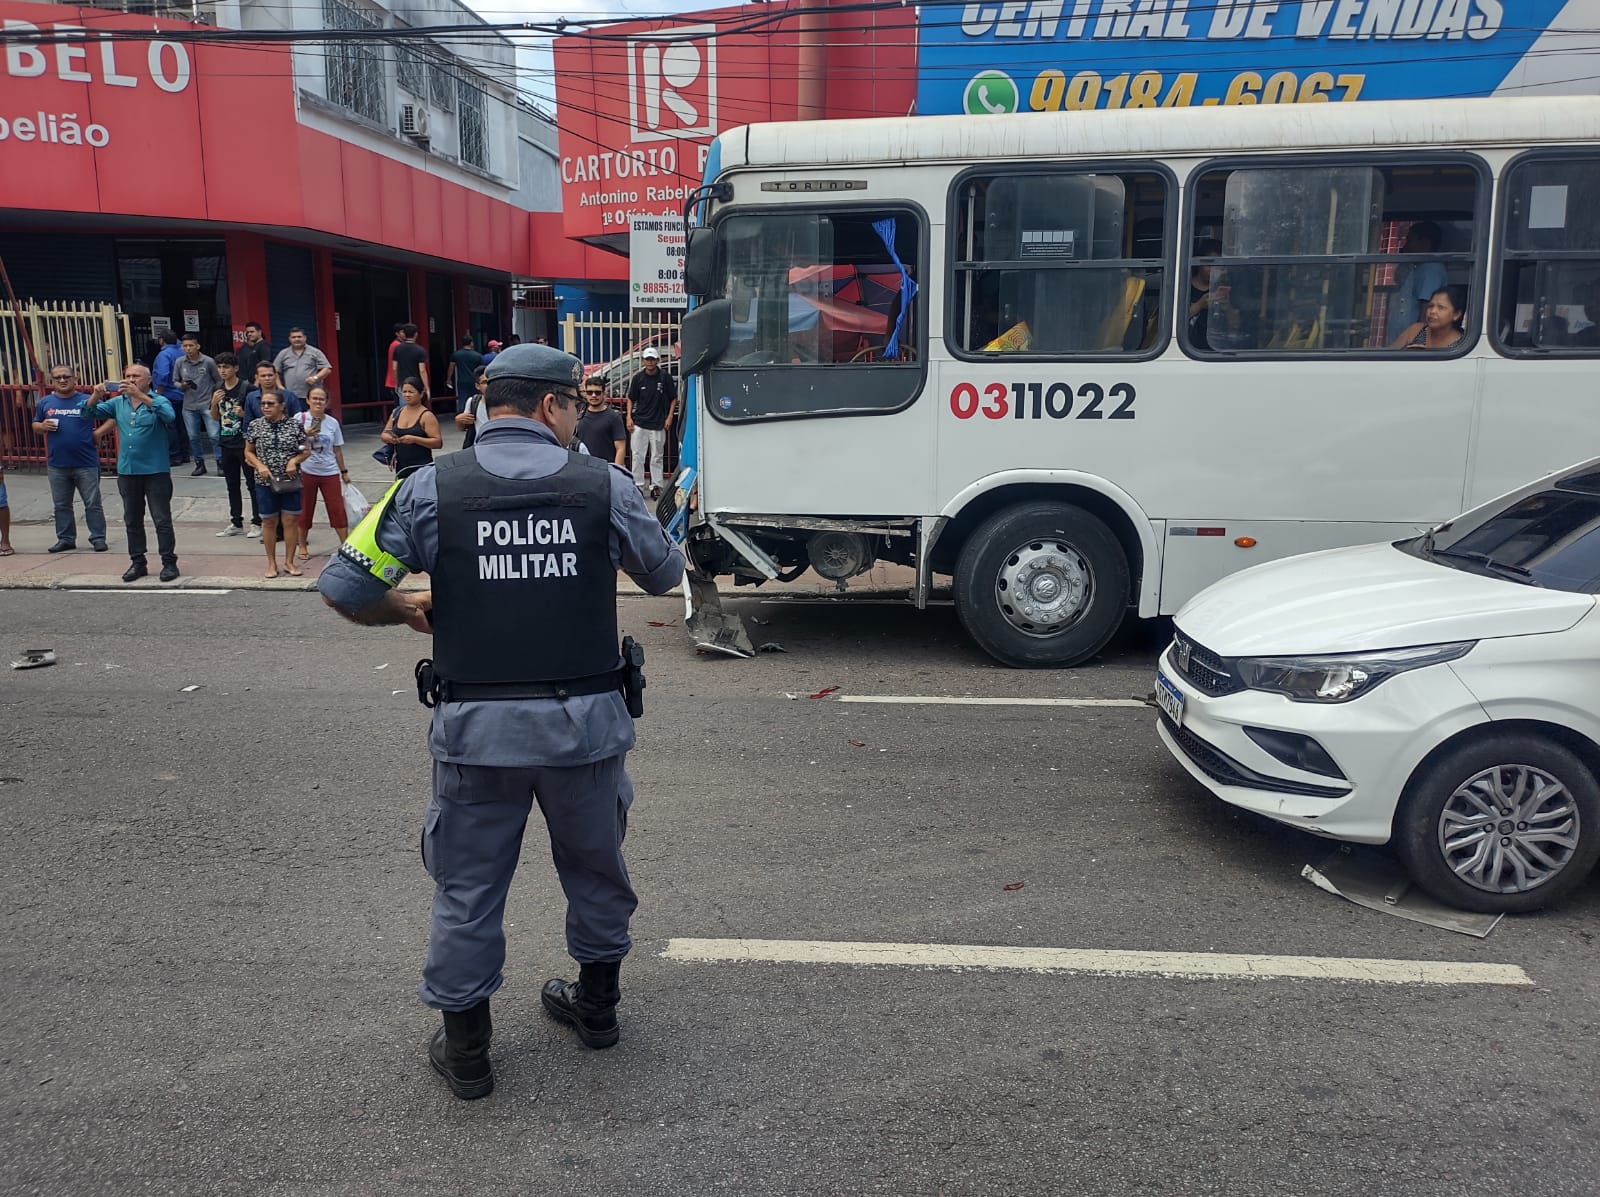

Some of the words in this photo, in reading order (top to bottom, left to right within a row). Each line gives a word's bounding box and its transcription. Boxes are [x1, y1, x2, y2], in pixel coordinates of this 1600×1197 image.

[961, 0, 1190, 37] CENTRAL
[1207, 0, 1280, 38] DE
[1296, 0, 1504, 40] VENDAS
[1029, 69, 1366, 112] 99184-6067
[561, 144, 676, 184] CARTÓRIO
[579, 189, 638, 207] Antonino
[646, 183, 697, 202] Rabelo
[774, 181, 853, 190] TORINO
[633, 220, 663, 232] ESTAMOS
[643, 282, 686, 294] 98855-121
[658, 269, 678, 280] 8:00
[949, 382, 1137, 420] 0311022
[477, 513, 577, 546] POLÍCIA
[478, 552, 578, 579] MILITAR
